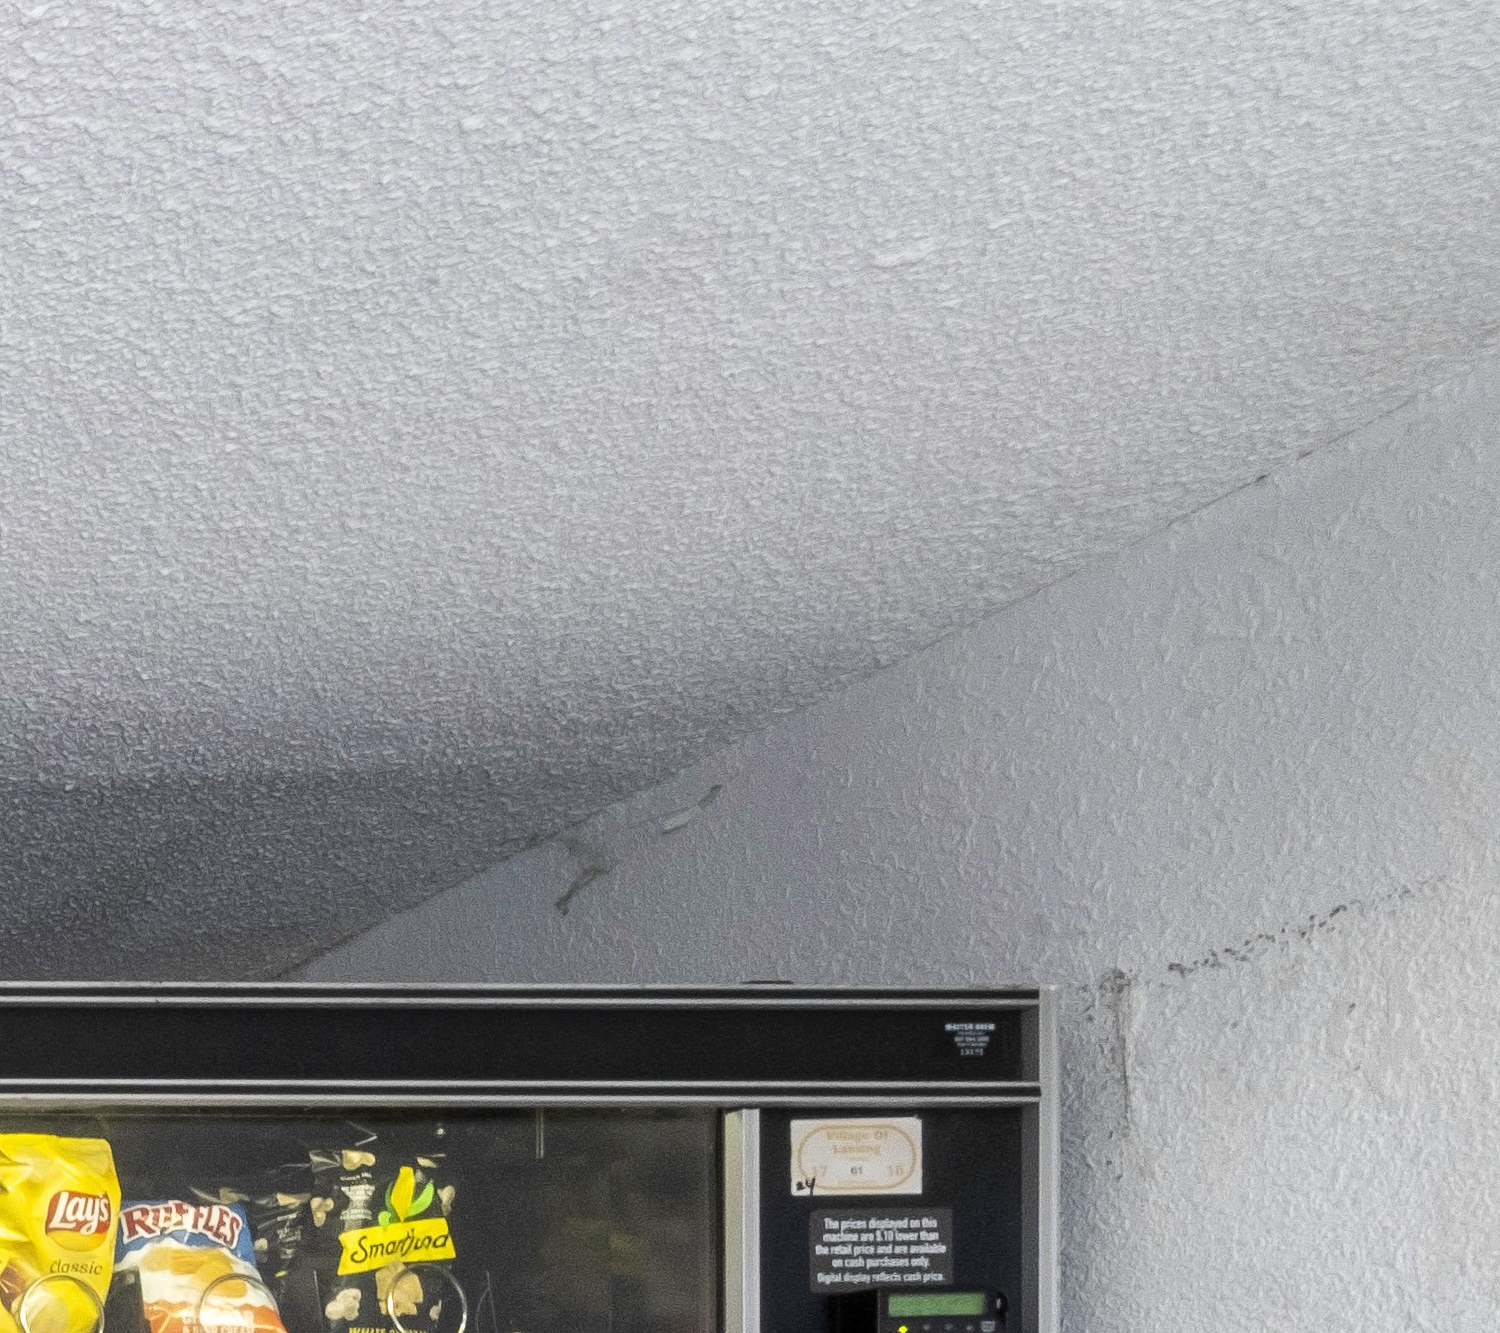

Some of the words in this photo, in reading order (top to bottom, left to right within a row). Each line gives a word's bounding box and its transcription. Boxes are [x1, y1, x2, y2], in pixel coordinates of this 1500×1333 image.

[51, 1190, 111, 1236] Lay's
[122, 1204, 241, 1249] RUFFLES
[824, 1217, 839, 1229] The
[841, 1218, 867, 1230] prices
[869, 1217, 908, 1230] displayed
[910, 1219, 921, 1228] on
[922, 1217, 938, 1228] this
[823, 1231, 859, 1241] machine
[860, 1233, 874, 1241] are
[895, 1230, 919, 1241] lower
[920, 1230, 939, 1241] than
[815, 1244, 829, 1255] the
[830, 1244, 852, 1255] retail
[853, 1245, 875, 1257] price
[876, 1244, 893, 1254] and
[894, 1245, 908, 1254] are
[909, 1243, 947, 1254] available
[831, 1258, 843, 1268] on
[844, 1257, 865, 1267] cash
[866, 1257, 909, 1270] purchases
[817, 1272, 842, 1284] Digital
[843, 1272, 870, 1285] display
[871, 1271, 901, 1283] reflects
[903, 1271, 922, 1282] cash
